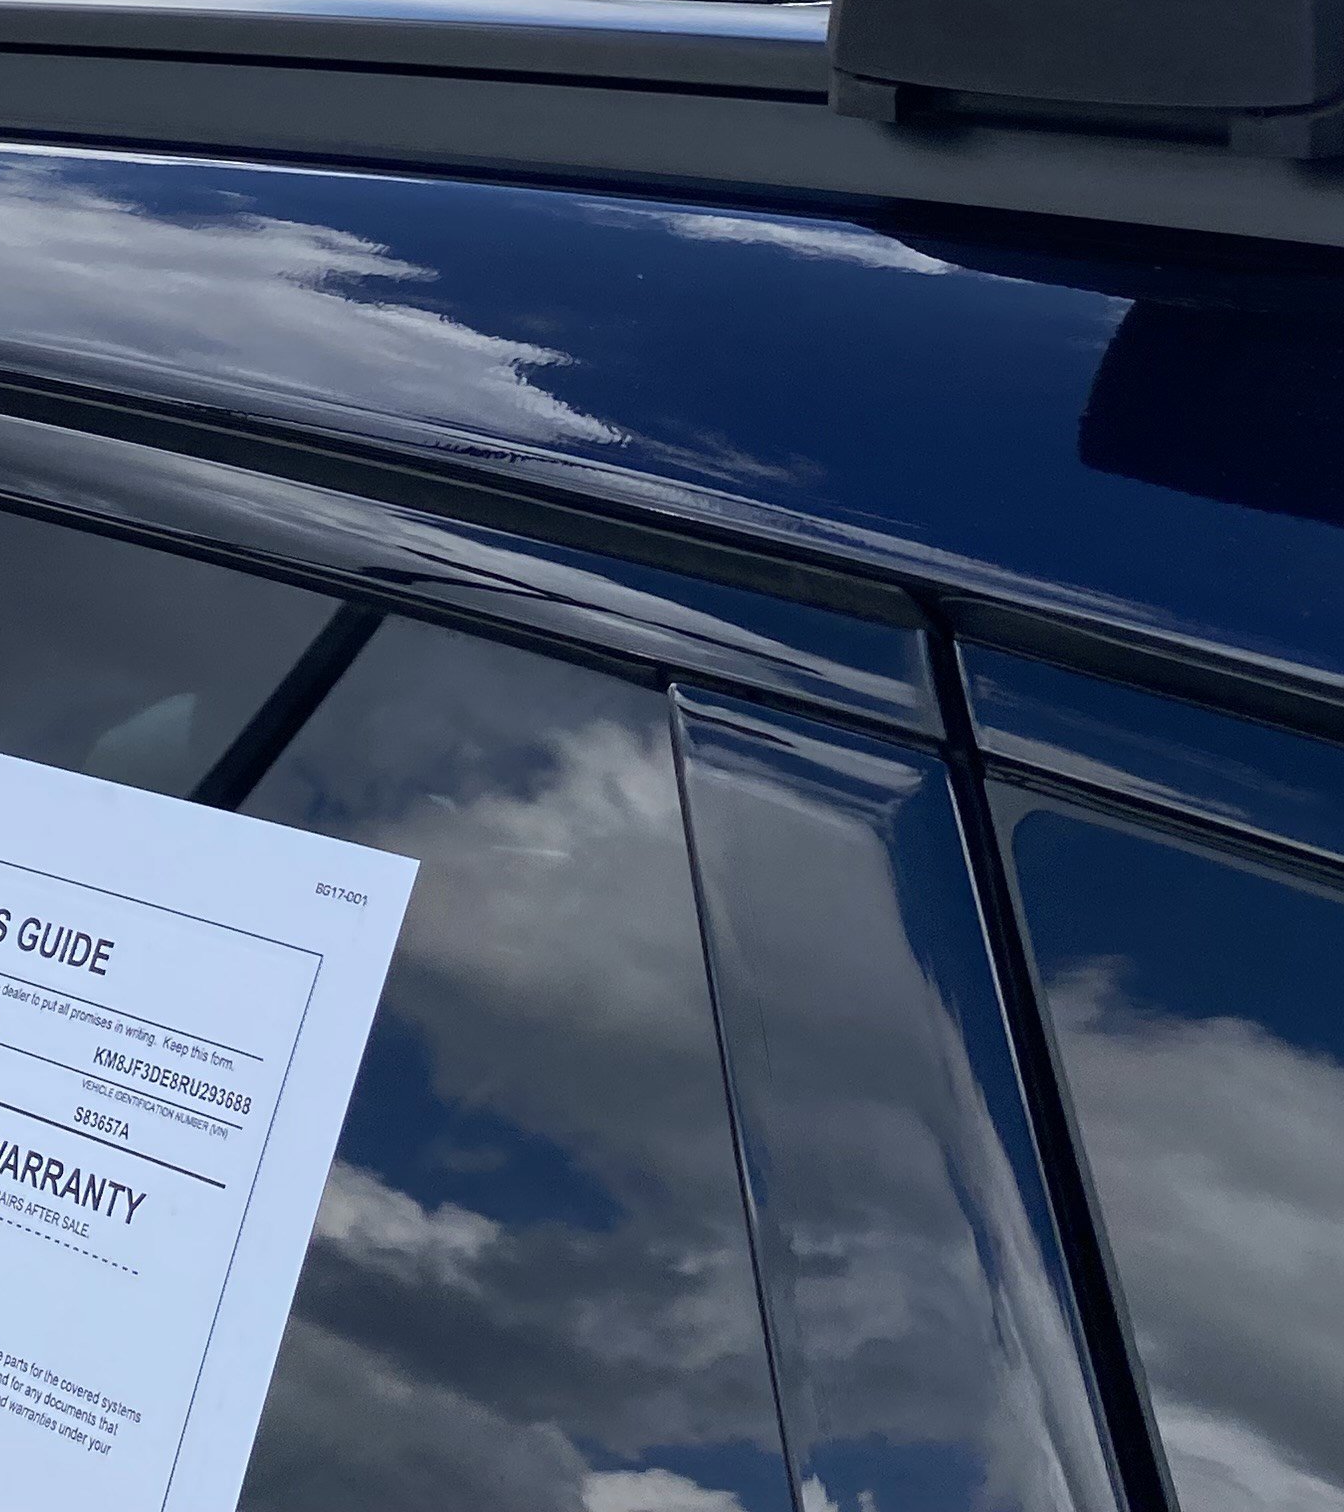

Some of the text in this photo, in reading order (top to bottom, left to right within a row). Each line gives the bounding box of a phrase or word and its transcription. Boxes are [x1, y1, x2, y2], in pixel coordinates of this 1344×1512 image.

[315, 882, 368, 908] BG17-001
[16, 916, 116, 976] GUIDE
[1, 983, 32, 1003] dealer
[30, 992, 41, 1007] to
[39, 998, 58, 1013] put
[57, 1002, 71, 1016] all
[68, 1008, 113, 1031] promises
[113, 1019, 124, 1035] in
[125, 1025, 157, 1048] writing.
[161, 1035, 190, 1058] Keep
[190, 1045, 209, 1063] this
[210, 1050, 234, 1072] form.
[82, 1078, 229, 1142] VEHICLE IDENTIFICATION NUMBER (VIN)
[92, 1045, 252, 1115] KM8JF3DE8RU293688
[73, 1105, 129, 1141] S83657A
[23, 1201, 61, 1227] AFTER
[61, 1215, 90, 1239] SALE.
[2, 1354, 29, 1373] parts
[29, 1362, 44, 1380] for
[43, 1369, 60, 1387] the
[59, 1378, 102, 1405] covered
[100, 1396, 142, 1424] systems
[9, 1375, 25, 1393] for
[24, 1385, 43, 1405] any
[43, 1391, 97, 1427] documents
[98, 1415, 119, 1437] that
[8, 1400, 58, 1431] warranties
[58, 1423, 89, 1446] under
[87, 1436, 112, 1456] your
